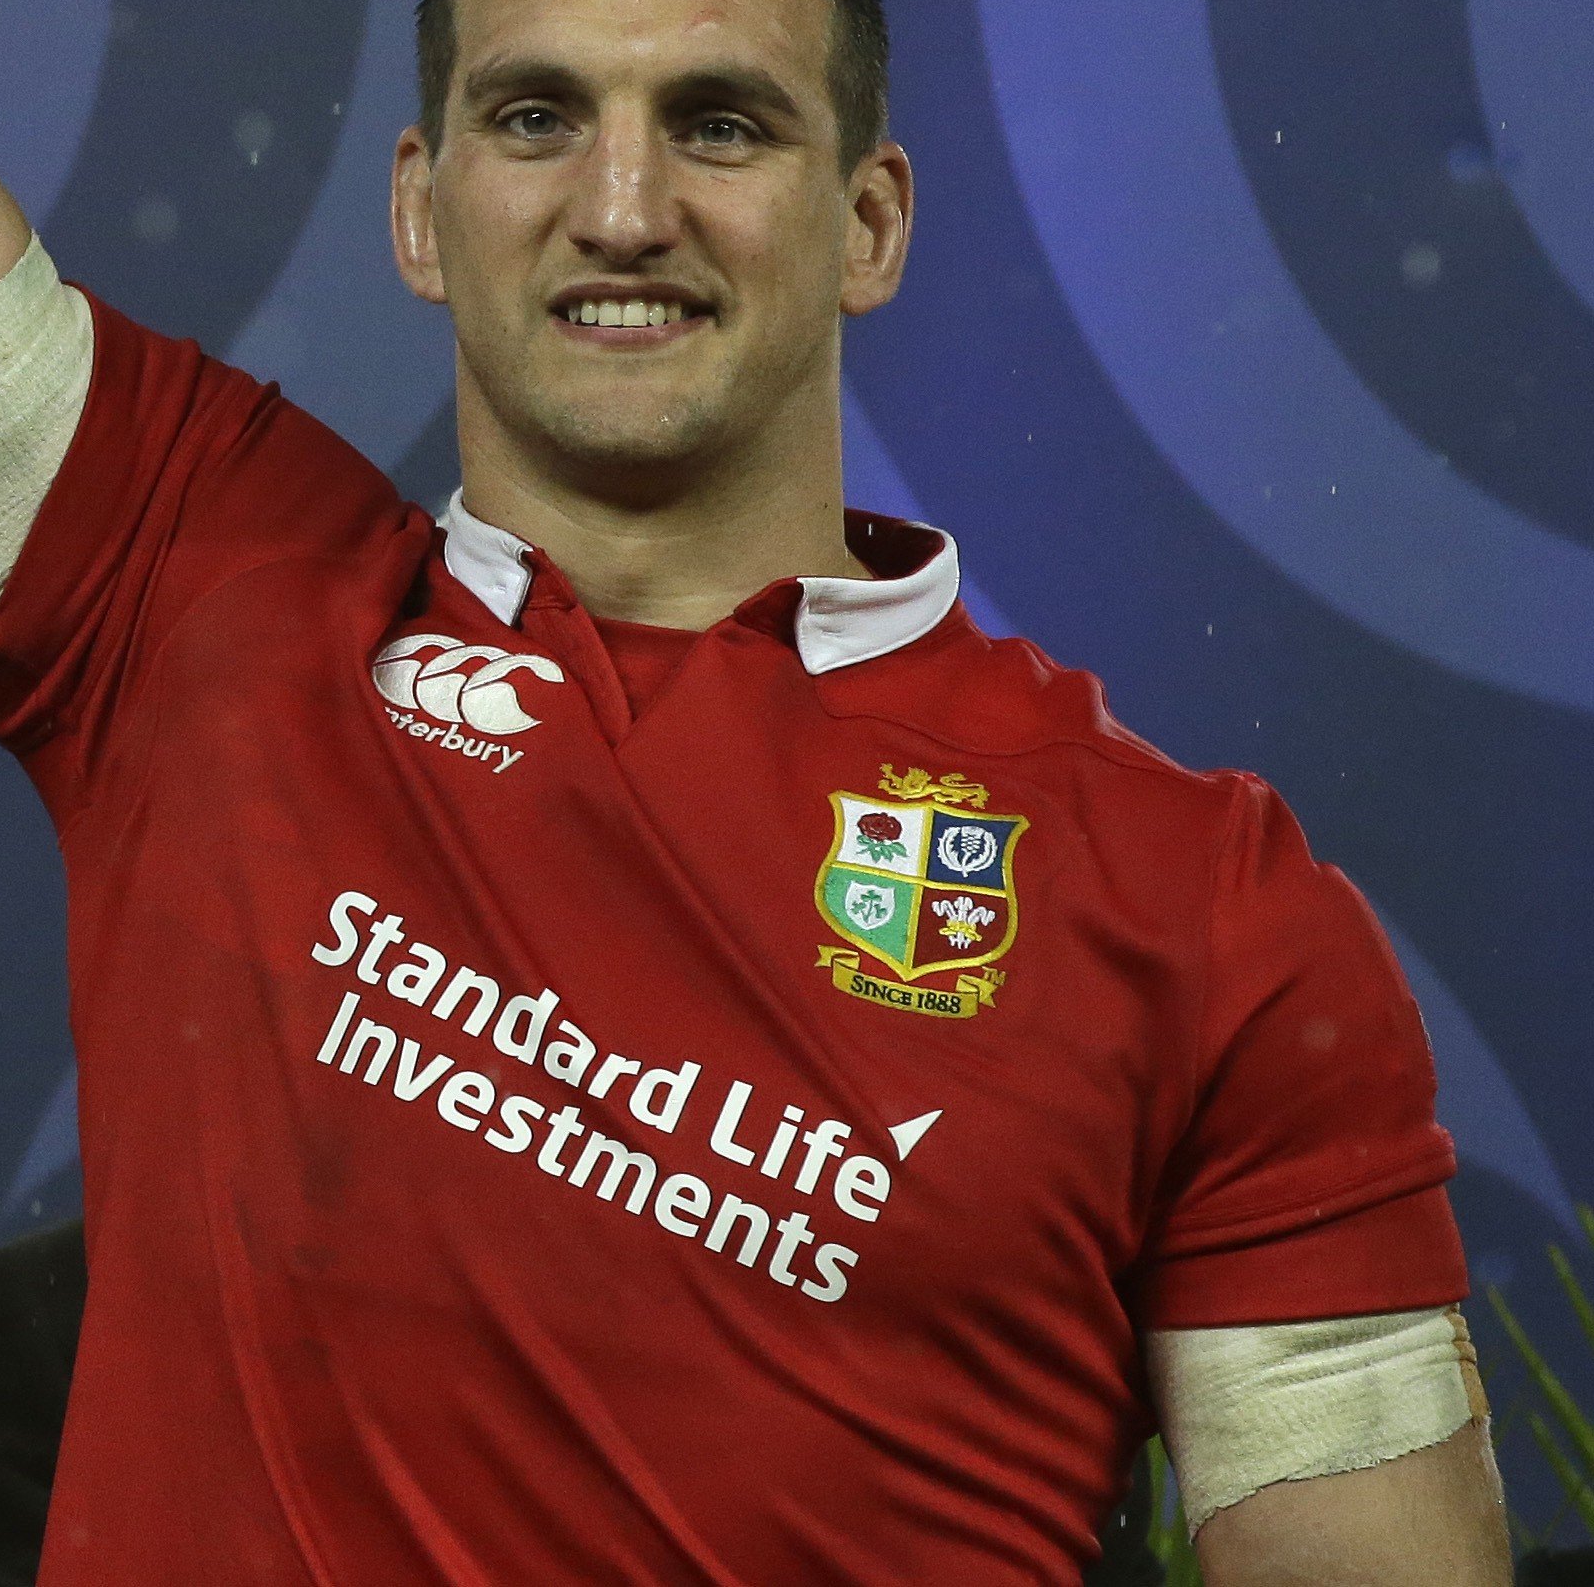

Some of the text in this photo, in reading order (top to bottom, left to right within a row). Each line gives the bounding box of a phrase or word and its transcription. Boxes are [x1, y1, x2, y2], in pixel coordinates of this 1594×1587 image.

[311, 890, 891, 1223] Standard Life
[316, 991, 860, 1303] Investments
[917, 991, 963, 1014] 1888
